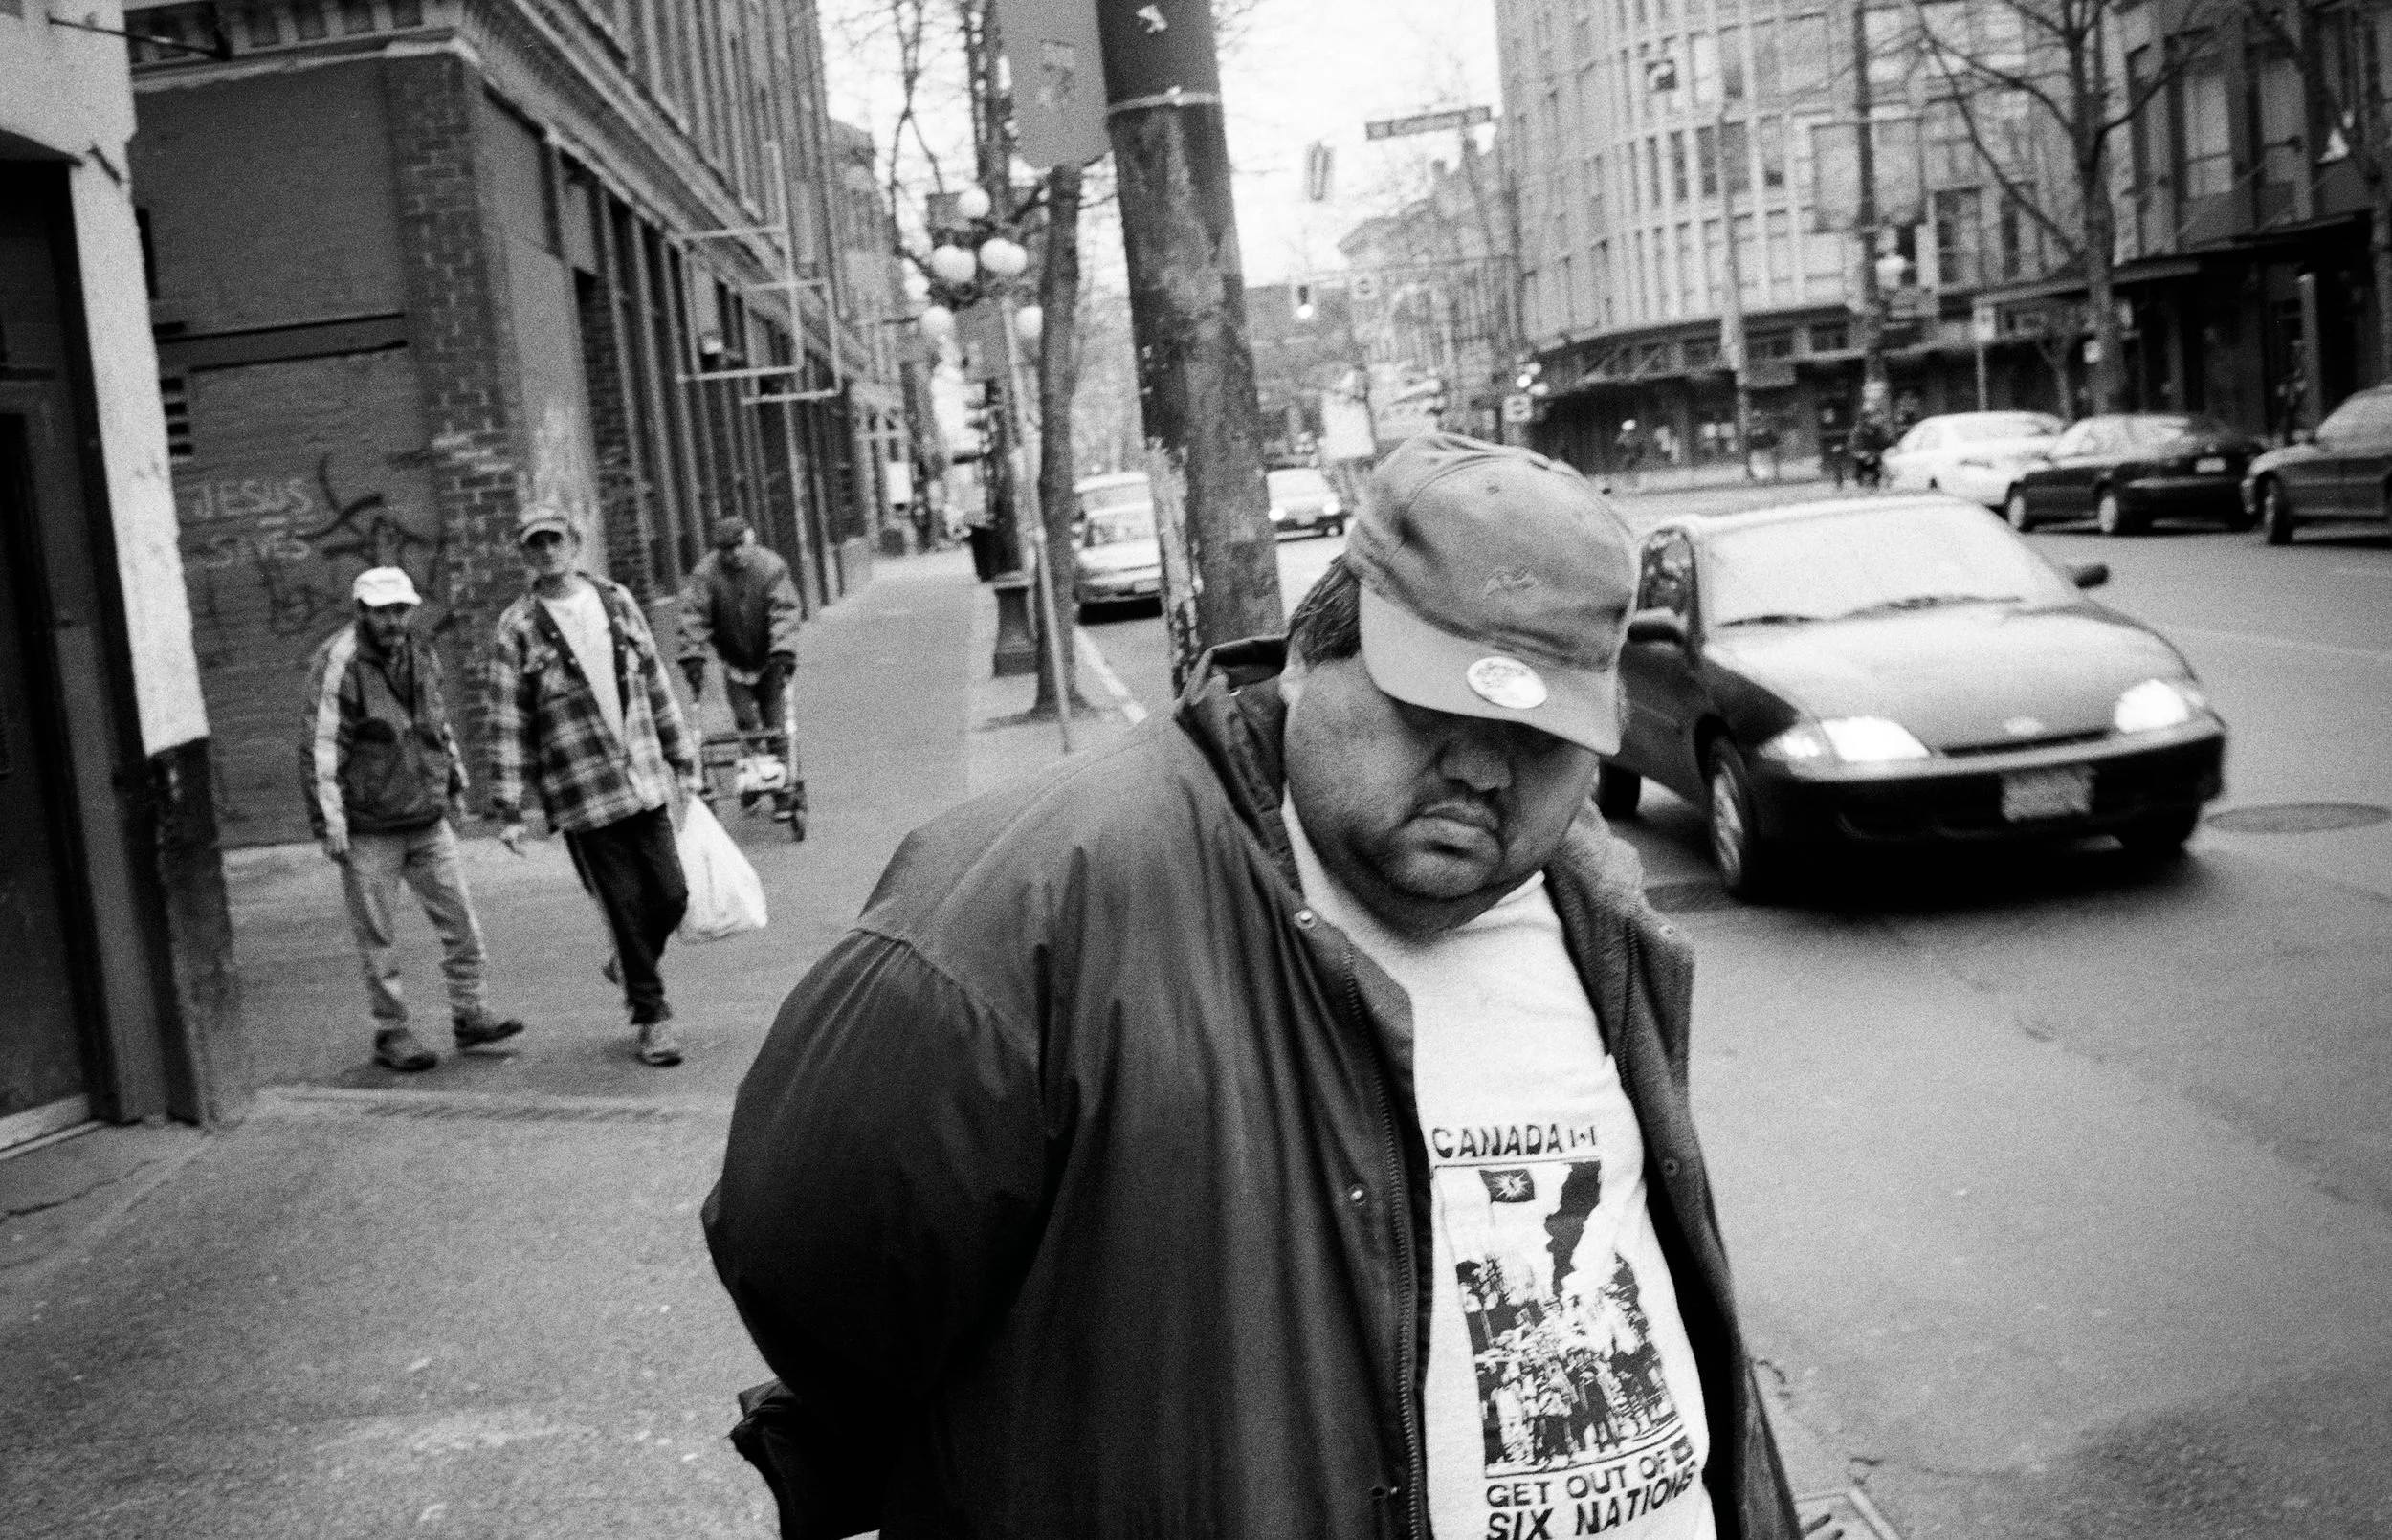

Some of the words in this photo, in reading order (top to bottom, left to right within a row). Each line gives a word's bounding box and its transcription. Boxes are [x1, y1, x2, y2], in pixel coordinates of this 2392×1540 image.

[194, 479, 313, 518] JESUS
[1431, 1123, 1563, 1159] CANADA
[1486, 1481, 1551, 1507] GET
[1566, 1464, 1627, 1499] OUT
[1638, 1450, 1667, 1480] OF
[1486, 1507, 1554, 1540] SIX
[1574, 1460, 1698, 1536] NATIONS
